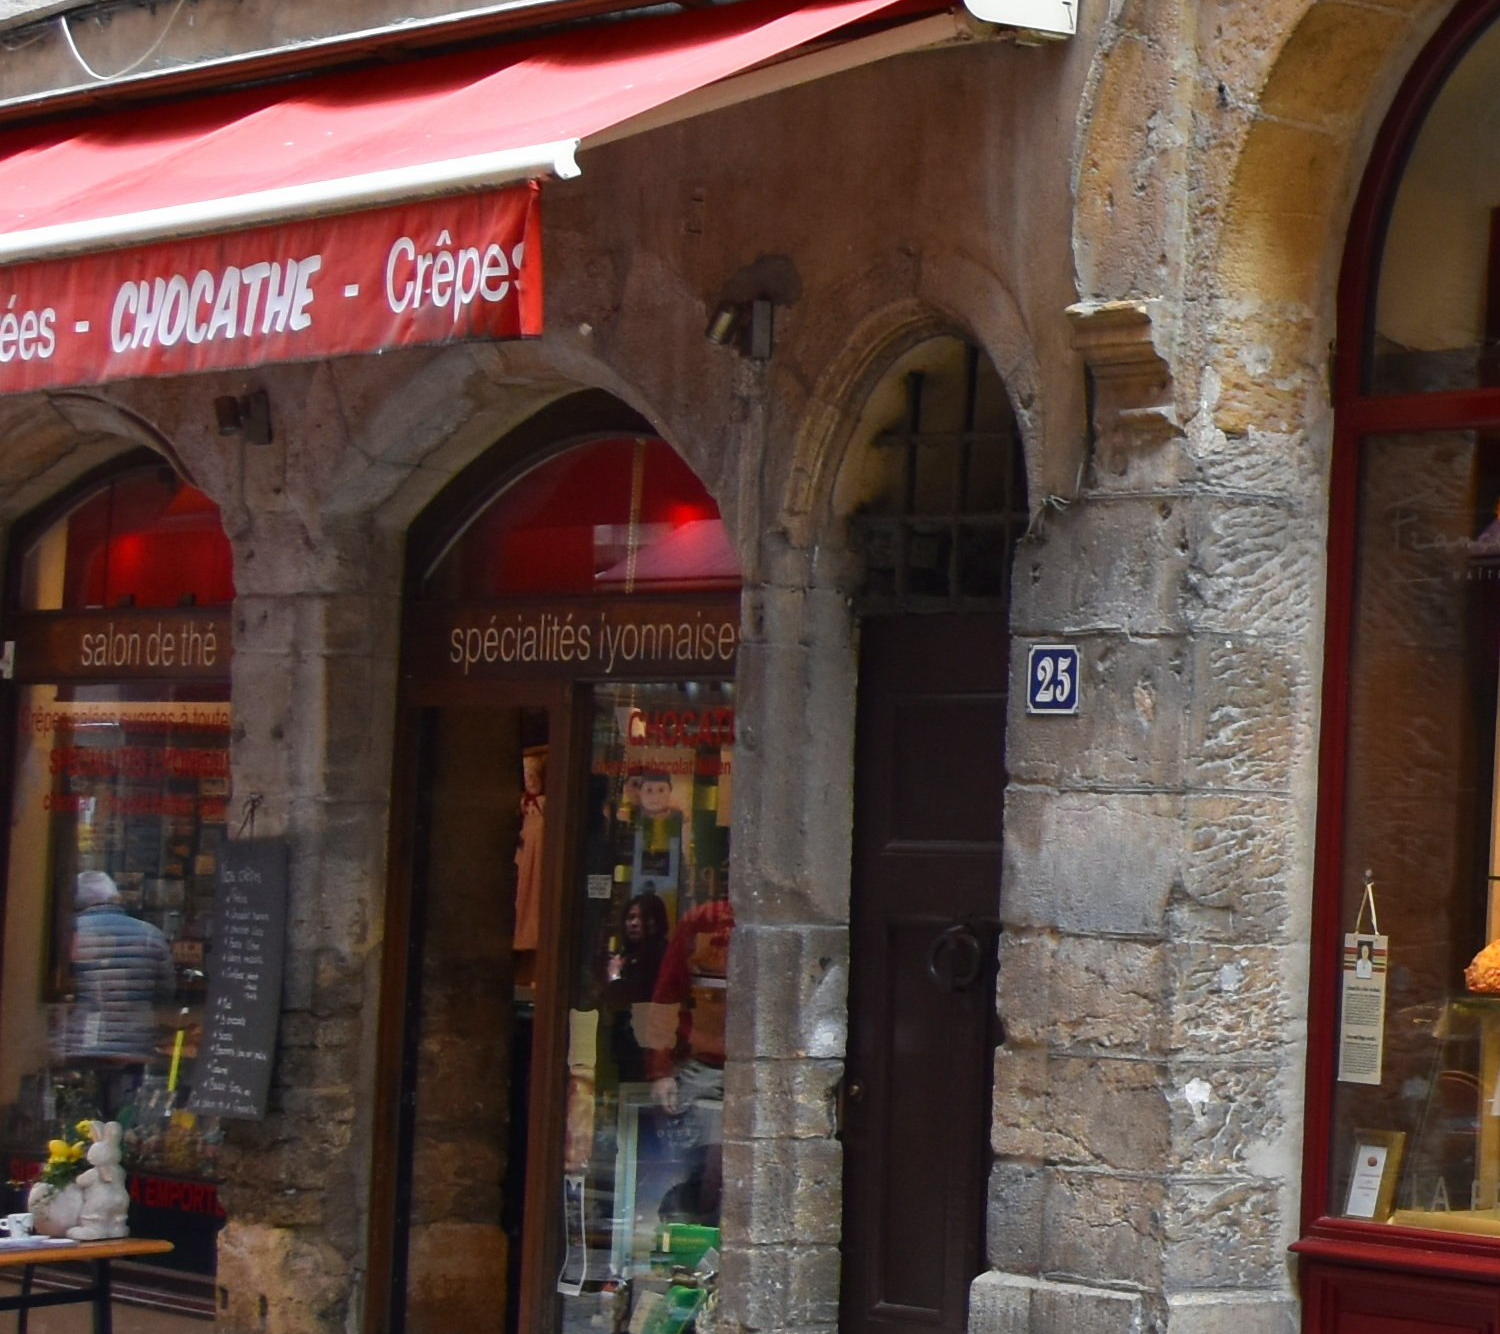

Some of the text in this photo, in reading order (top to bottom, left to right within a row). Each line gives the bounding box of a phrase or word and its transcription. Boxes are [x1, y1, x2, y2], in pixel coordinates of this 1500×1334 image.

[111, 255, 322, 354] CHOCATHE
[81, 622, 218, 667] salon de thé
[450, 613, 592, 676] spécialités
[1035, 656, 1072, 703] 25
